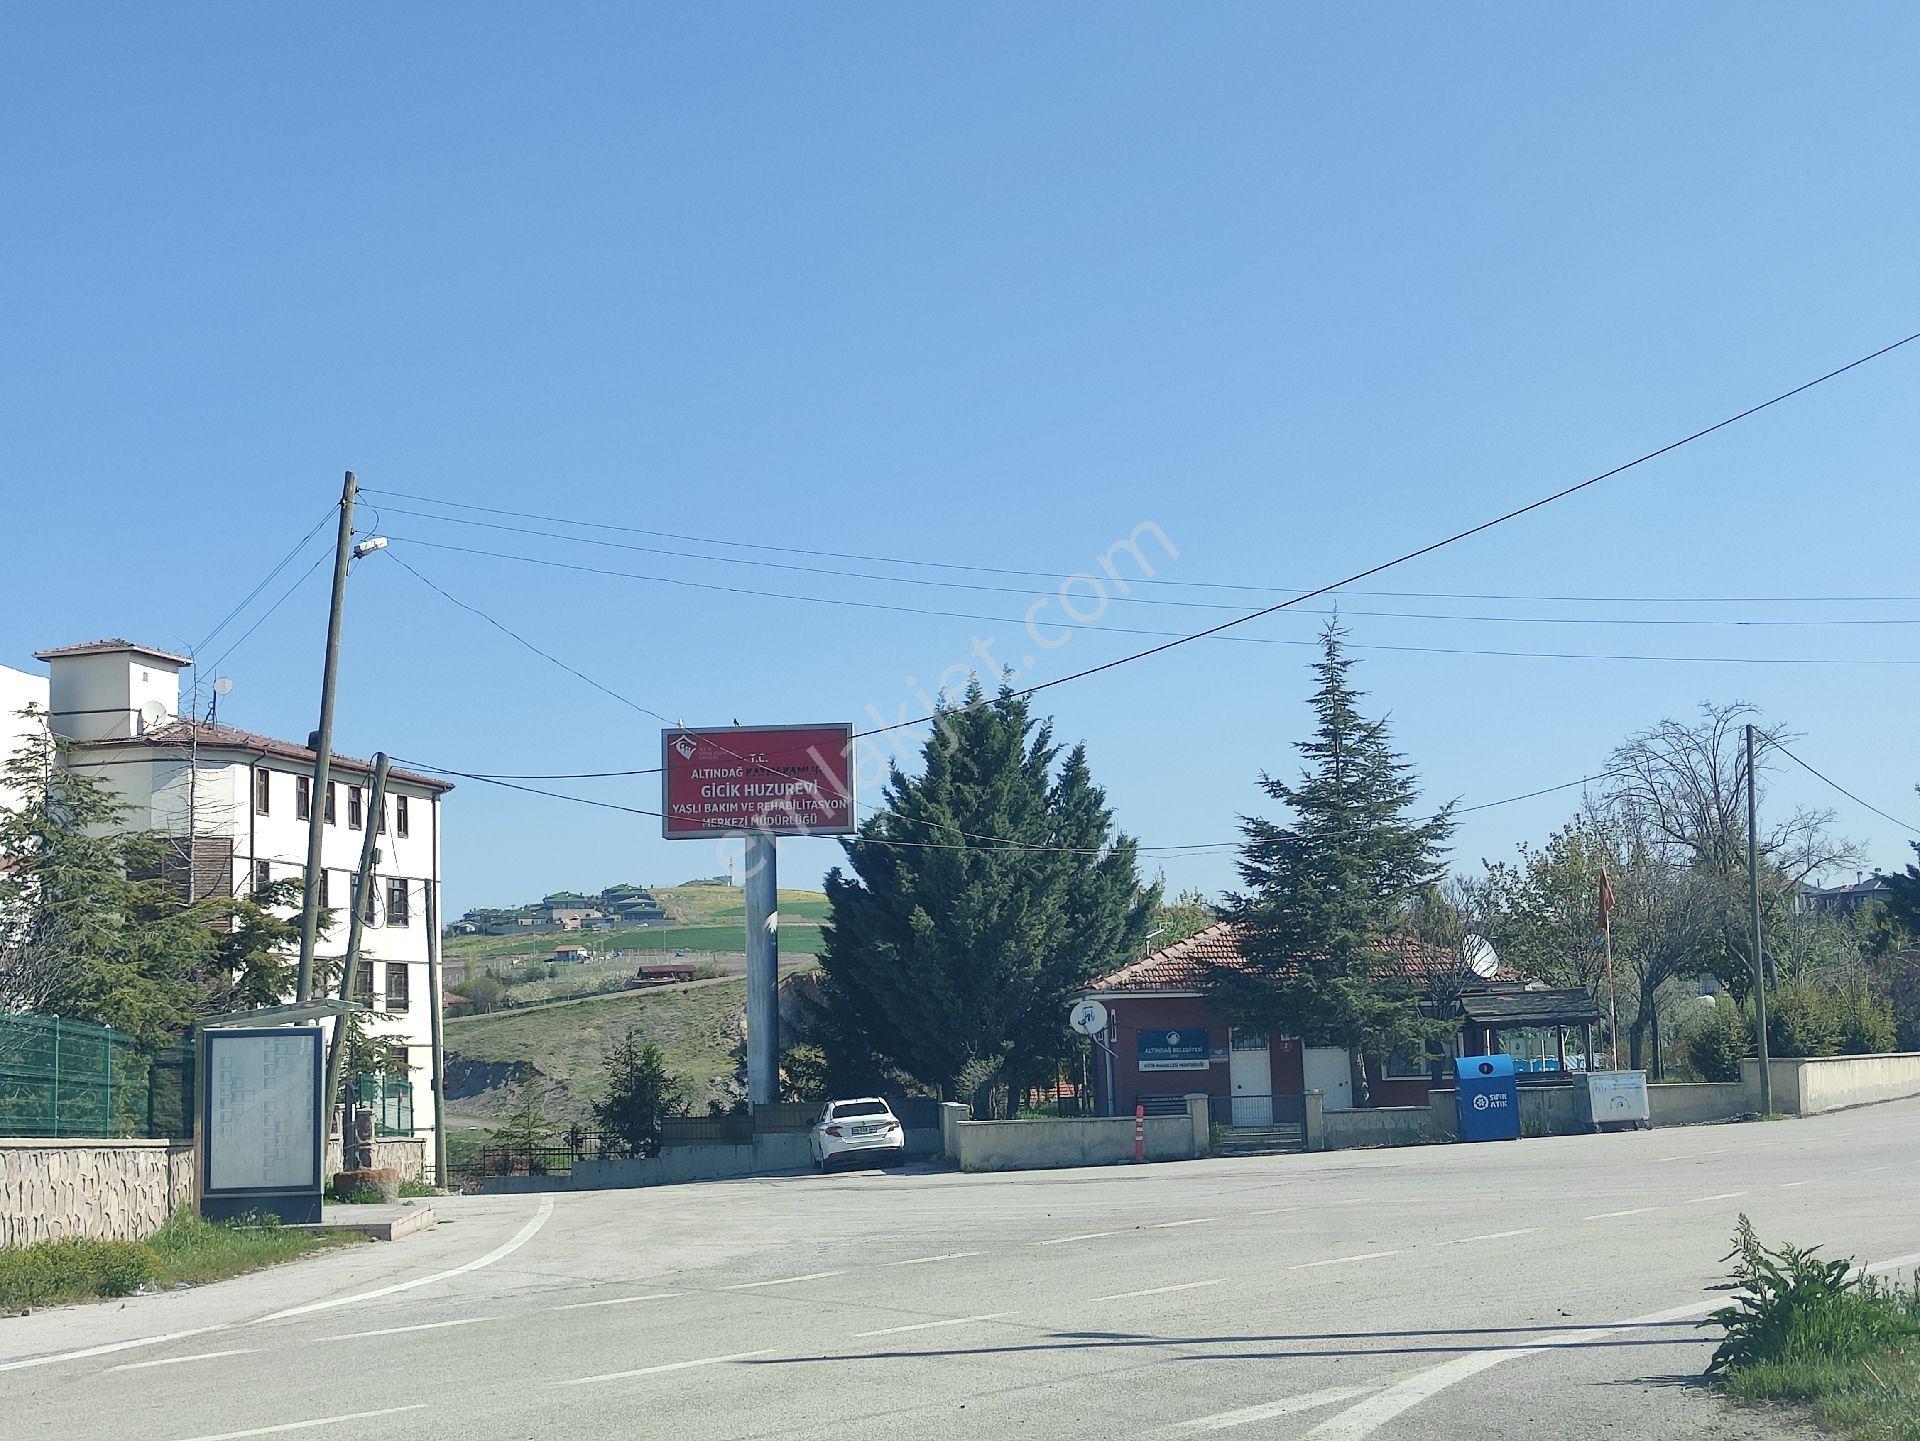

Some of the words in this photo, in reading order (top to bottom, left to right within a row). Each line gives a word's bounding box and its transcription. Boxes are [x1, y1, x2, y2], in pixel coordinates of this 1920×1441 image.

[691, 766, 743, 780] ALTINDAĞ
[701, 783, 740, 798] GİCİK
[745, 779, 818, 798] HUZUREVİ
[672, 804, 701, 815] YAŞLI
[704, 802, 738, 813] BAKIM
[741, 802, 754, 812] VE
[757, 798, 847, 811] REHABİLİTASYON
[702, 815, 748, 828] MERKEZİ
[751, 812, 818, 827] MÜDÜRLÜĞÜ
[1144, 1046, 1172, 1054] ALTINDAĞ
[1173, 1045, 1203, 1054] BELEDİYESİ
[1490, 1100, 1508, 1108] ATIK
